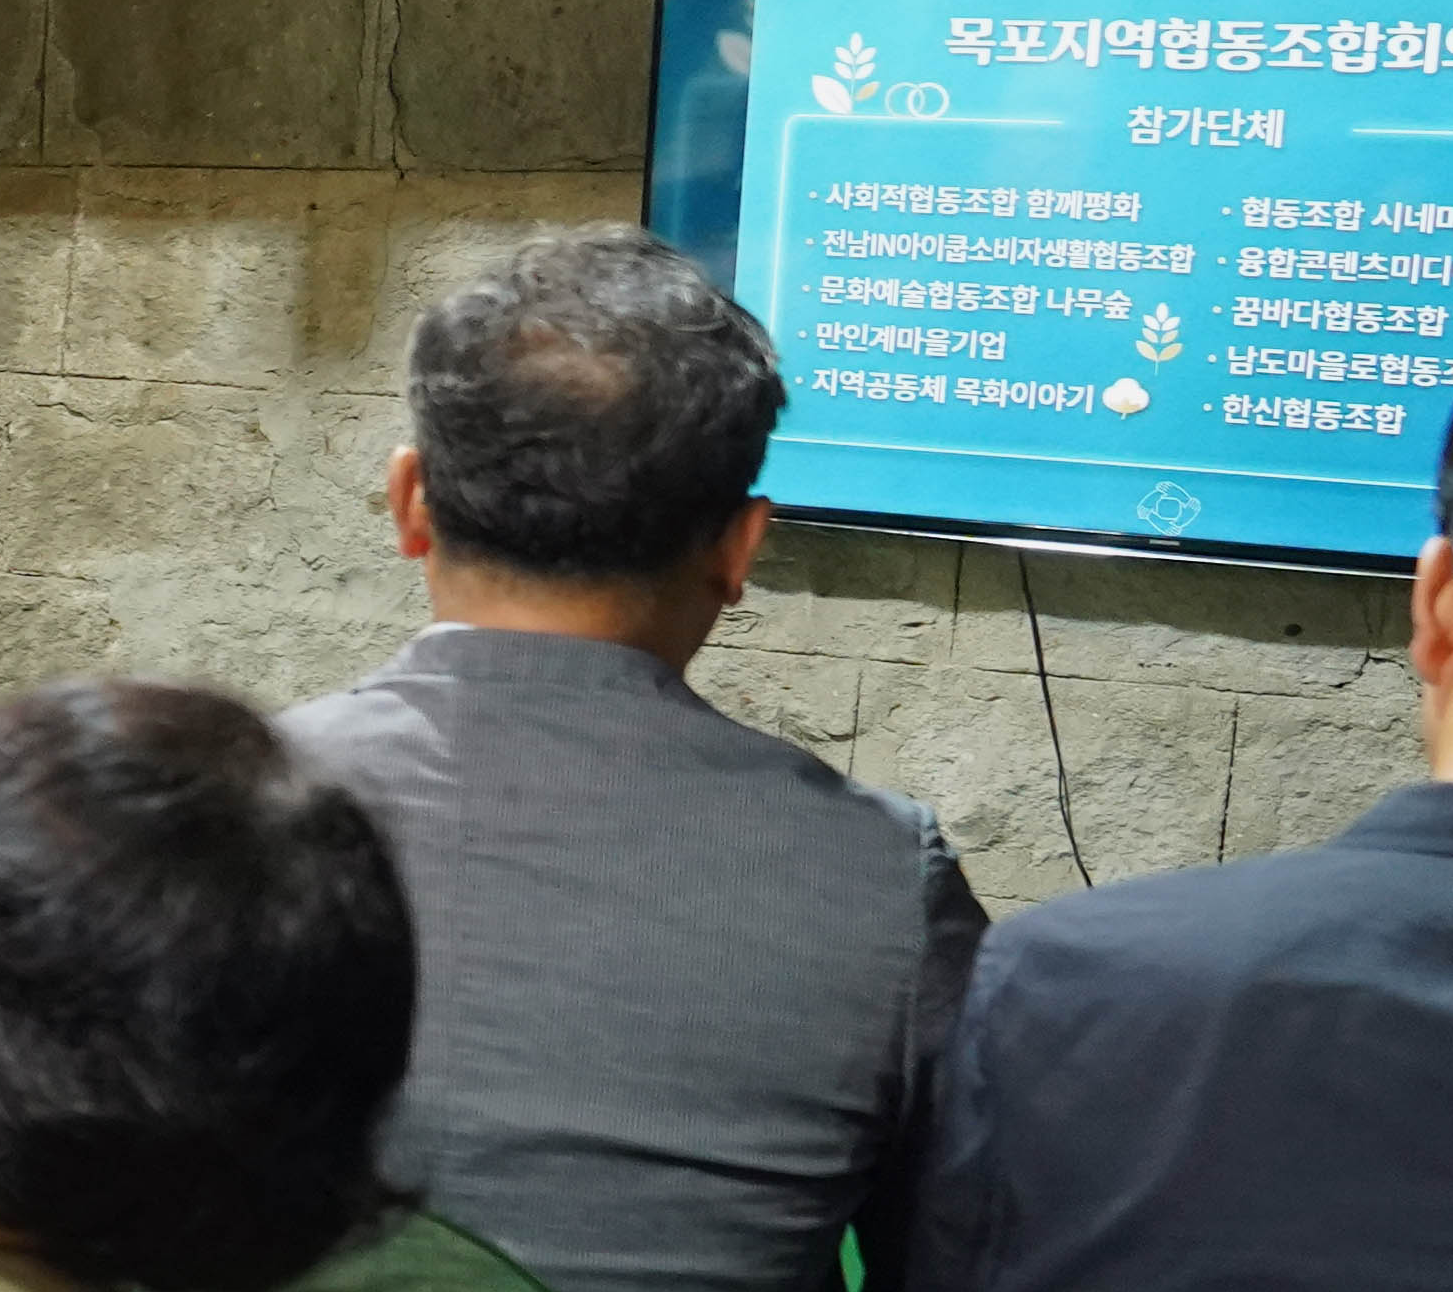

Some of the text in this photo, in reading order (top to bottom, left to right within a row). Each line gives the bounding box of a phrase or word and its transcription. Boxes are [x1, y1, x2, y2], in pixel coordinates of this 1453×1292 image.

[1126, 105, 1285, 149] 참가단체
[825, 181, 1143, 223] 사회적협동조합 함께평화
[1241, 196, 1366, 231] 협동조합
[822, 228, 1196, 275] 전남IN아이쿱소비자생활협동조합
[818, 275, 1133, 321] 문화예술협동조합 나무숲
[1231, 296, 1450, 338] 꿈바다협동조합
[816, 320, 1007, 361] 만인계마을기업
[811, 367, 1096, 415] 지역공동체 목화이야기
[1222, 393, 1407, 436] 한신협동조합
